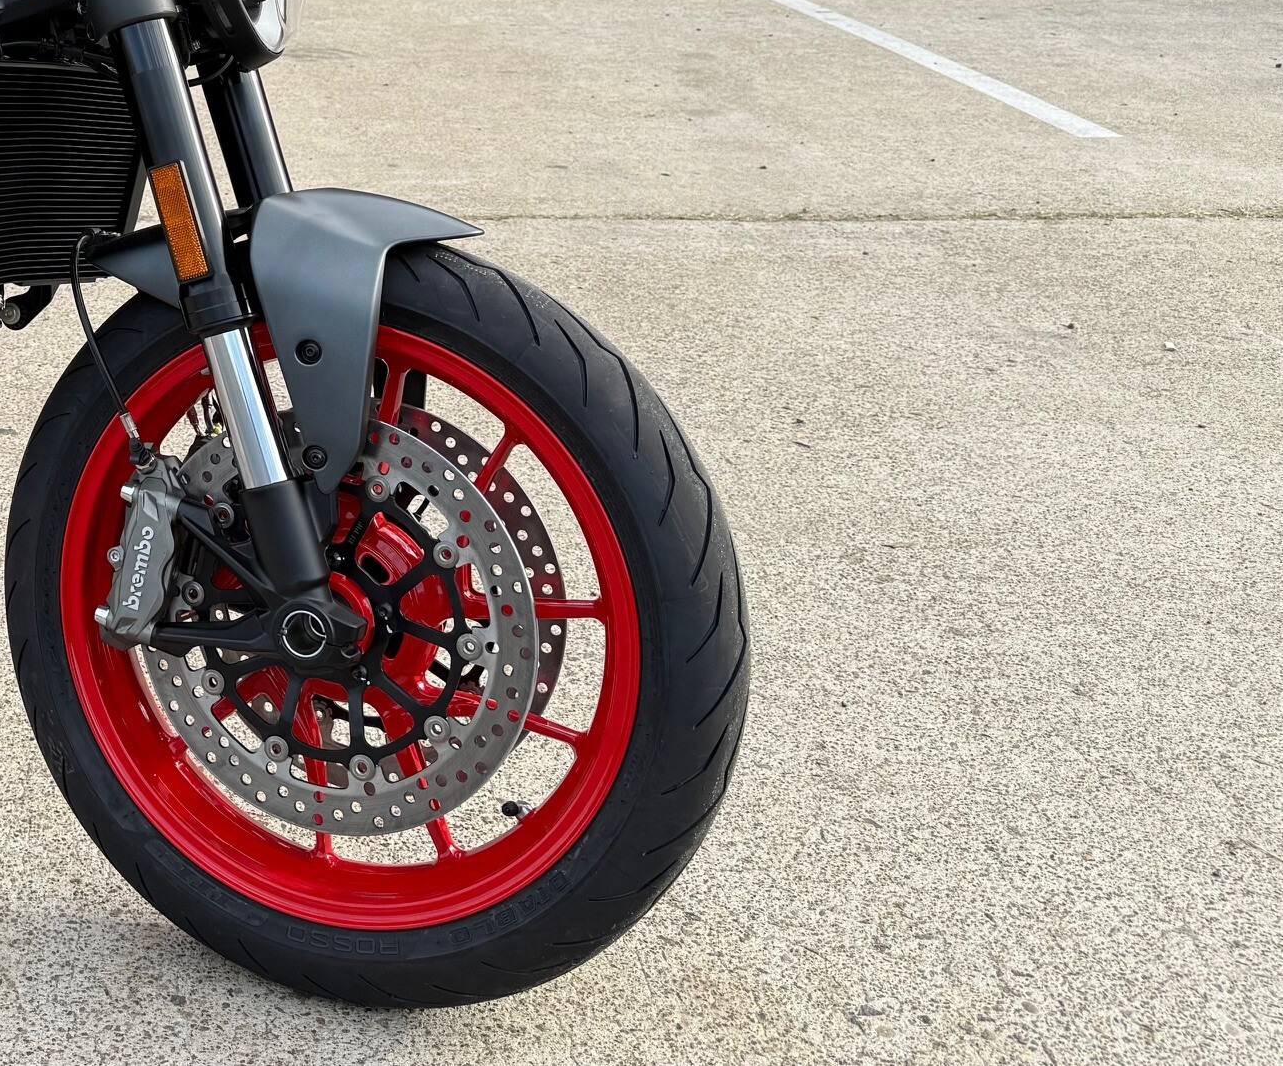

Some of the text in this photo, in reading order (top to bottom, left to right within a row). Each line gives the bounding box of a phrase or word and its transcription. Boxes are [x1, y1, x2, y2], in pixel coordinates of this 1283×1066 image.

[122, 526, 155, 611] brembo
[286, 871, 569, 956] DIABLO ROSSO
